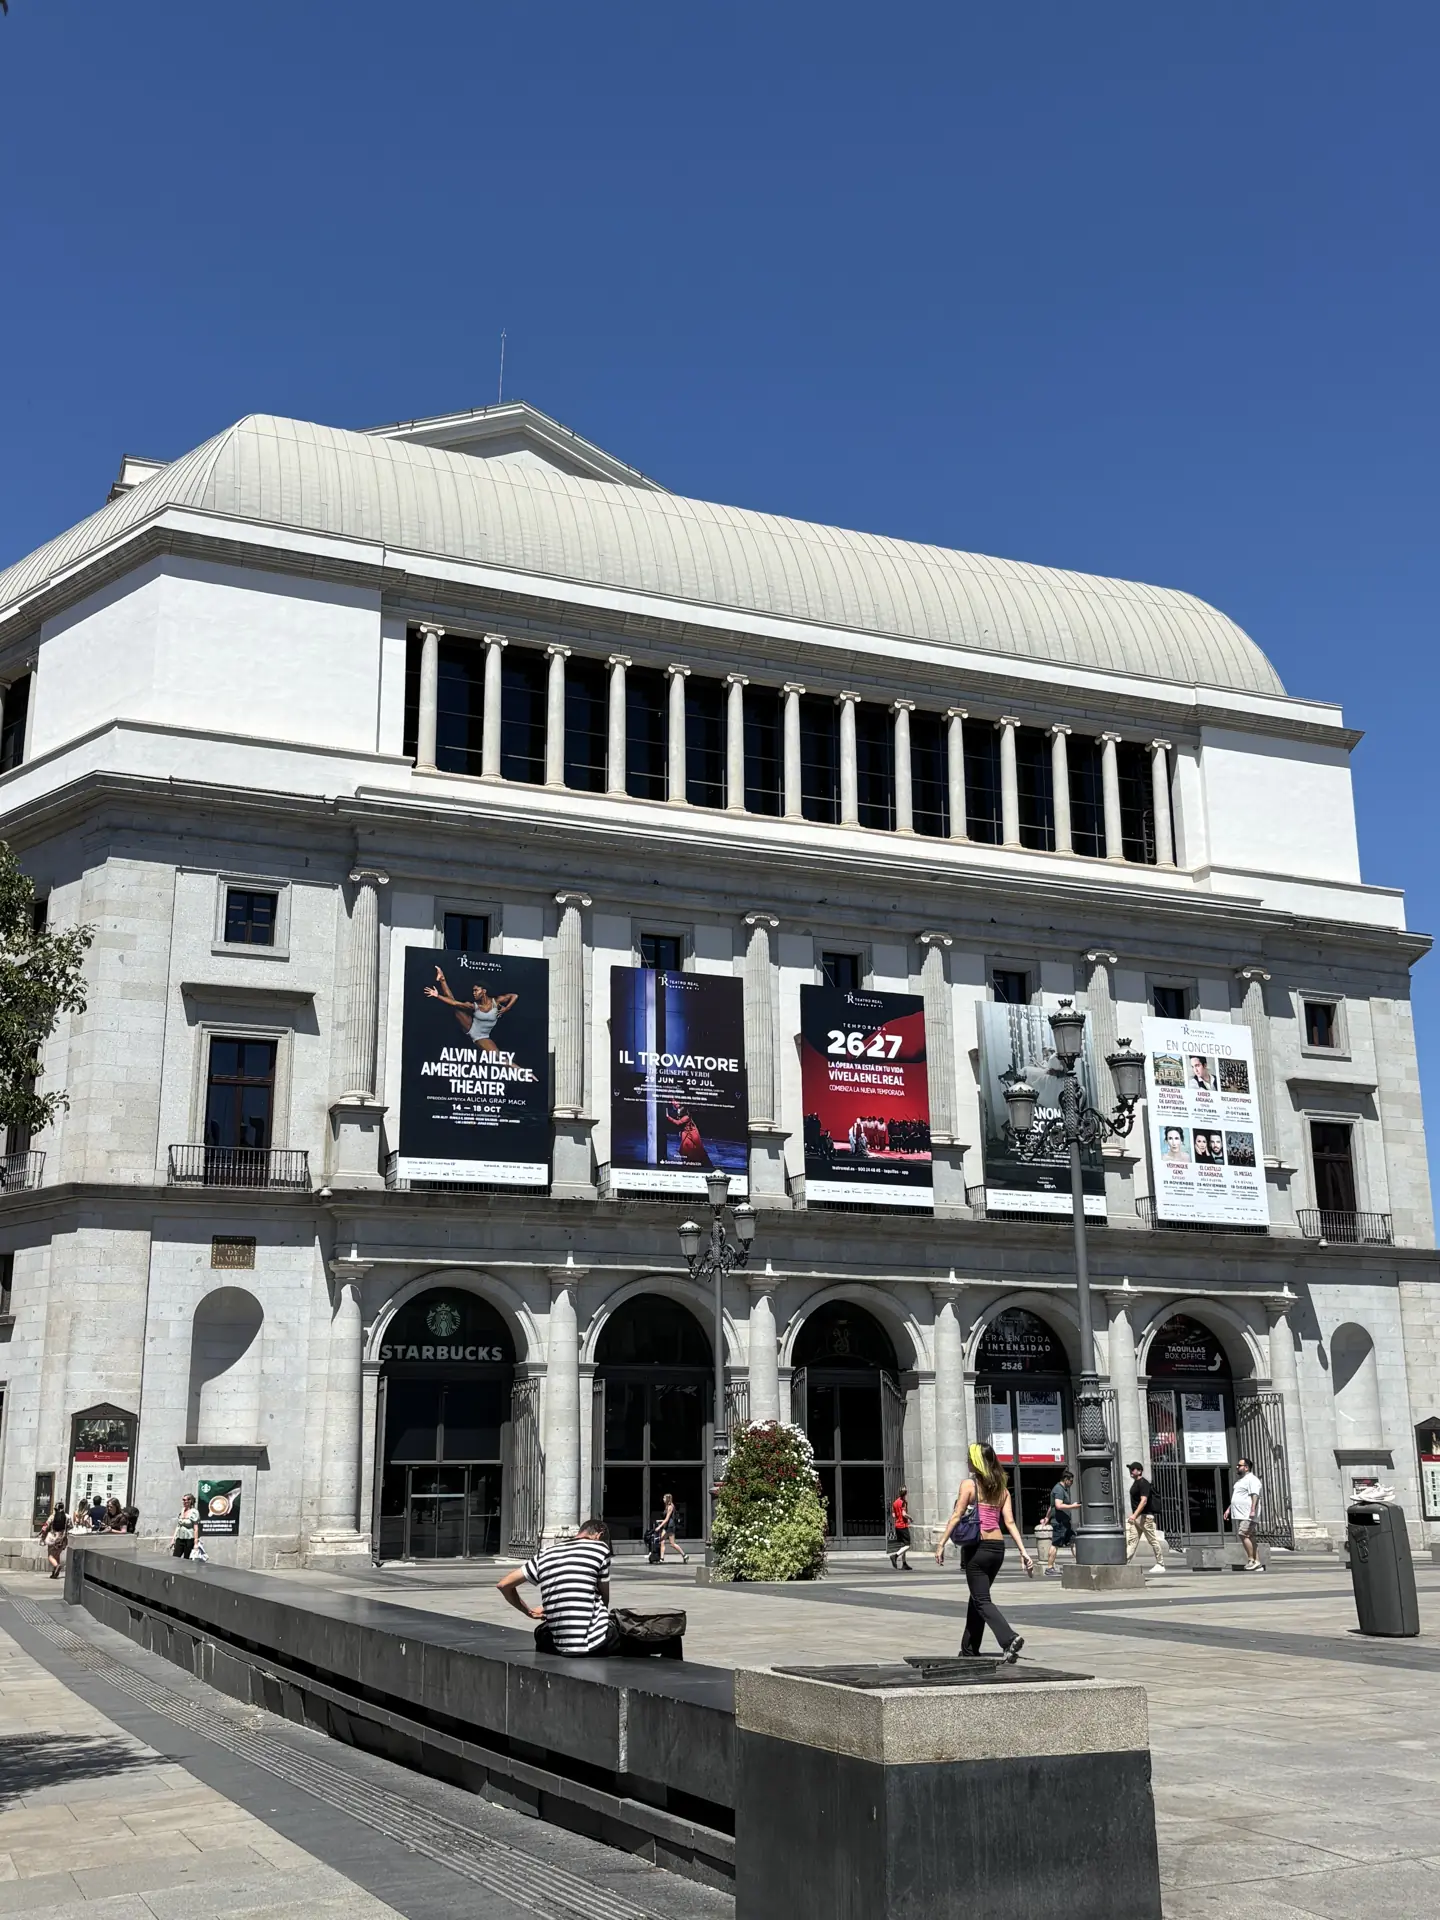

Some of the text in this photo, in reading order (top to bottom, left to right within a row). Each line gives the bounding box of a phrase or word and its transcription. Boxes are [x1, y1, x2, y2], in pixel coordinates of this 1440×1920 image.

[843, 1022, 887, 1031] TEMPORADA
[1166, 1039, 1232, 1056] EN CONCIERTO
[440, 1047, 515, 1065] ALVIN AILEY
[619, 1050, 739, 1072] IL TROVATORE
[421, 1062, 533, 1082] AMERICAN DANCE
[835, 1061, 854, 1069] ÓPERA
[862, 1063, 875, 1071] ESTÁ
[659, 1069, 689, 1077] GIUSEPPE
[690, 1070, 710, 1078] VERDI
[828, 1069, 904, 1086] VÍVELA EN EL REAL
[449, 1079, 505, 1096] THEATER
[699, 1079, 715, 1087] JUL
[829, 1084, 853, 1092] COMIENZA
[877, 1088, 905, 1096] TEMPORADA
[1034, 1106, 1062, 1120] ANON
[1024, 1335, 1050, 1343] TODA
[381, 1344, 503, 1361] STARBUCKS
[988, 1343, 1051, 1352] INTENSIDAD
[1167, 1345, 1206, 1353] TAQUILLAS
